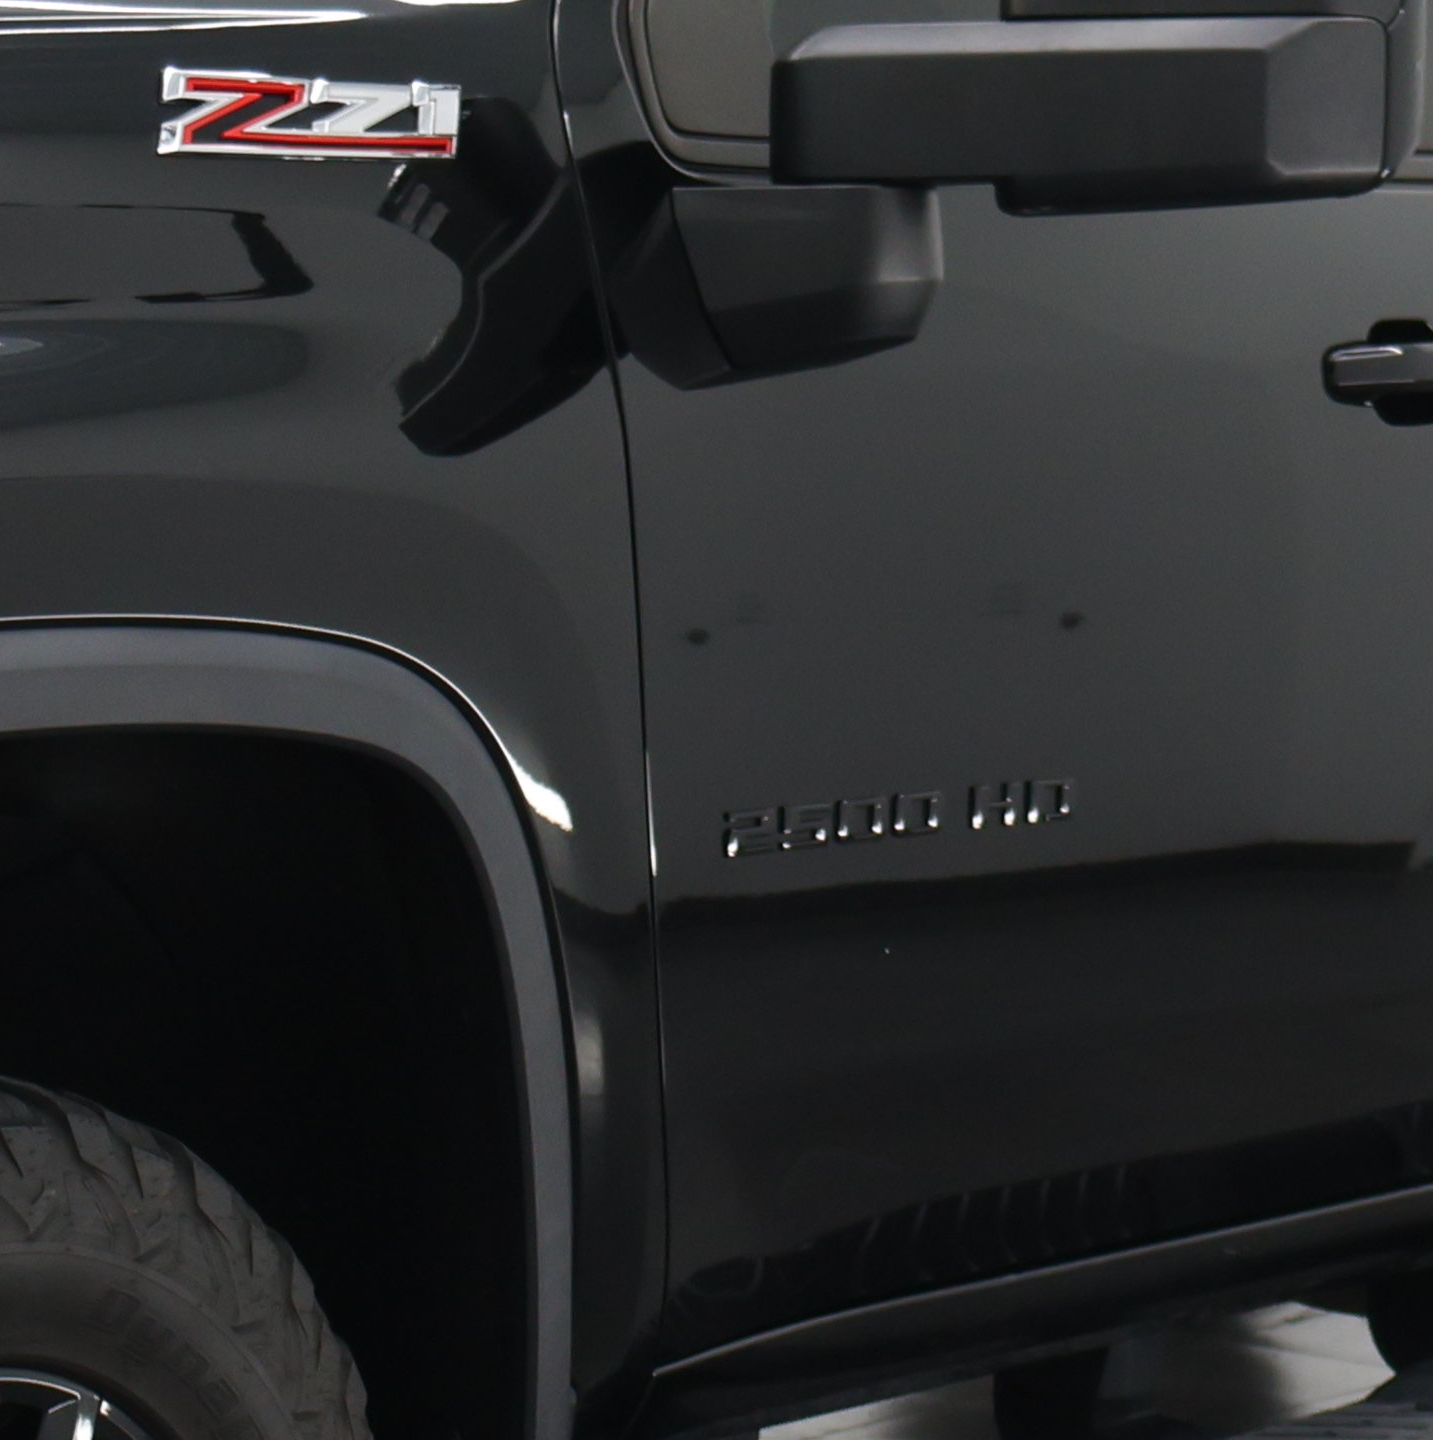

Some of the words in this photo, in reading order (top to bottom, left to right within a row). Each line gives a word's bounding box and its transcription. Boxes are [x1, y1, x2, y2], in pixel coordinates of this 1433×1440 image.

[157, 66, 462, 159] Z71
[722, 790, 942, 859] 2500
[968, 778, 1074, 831] HD
